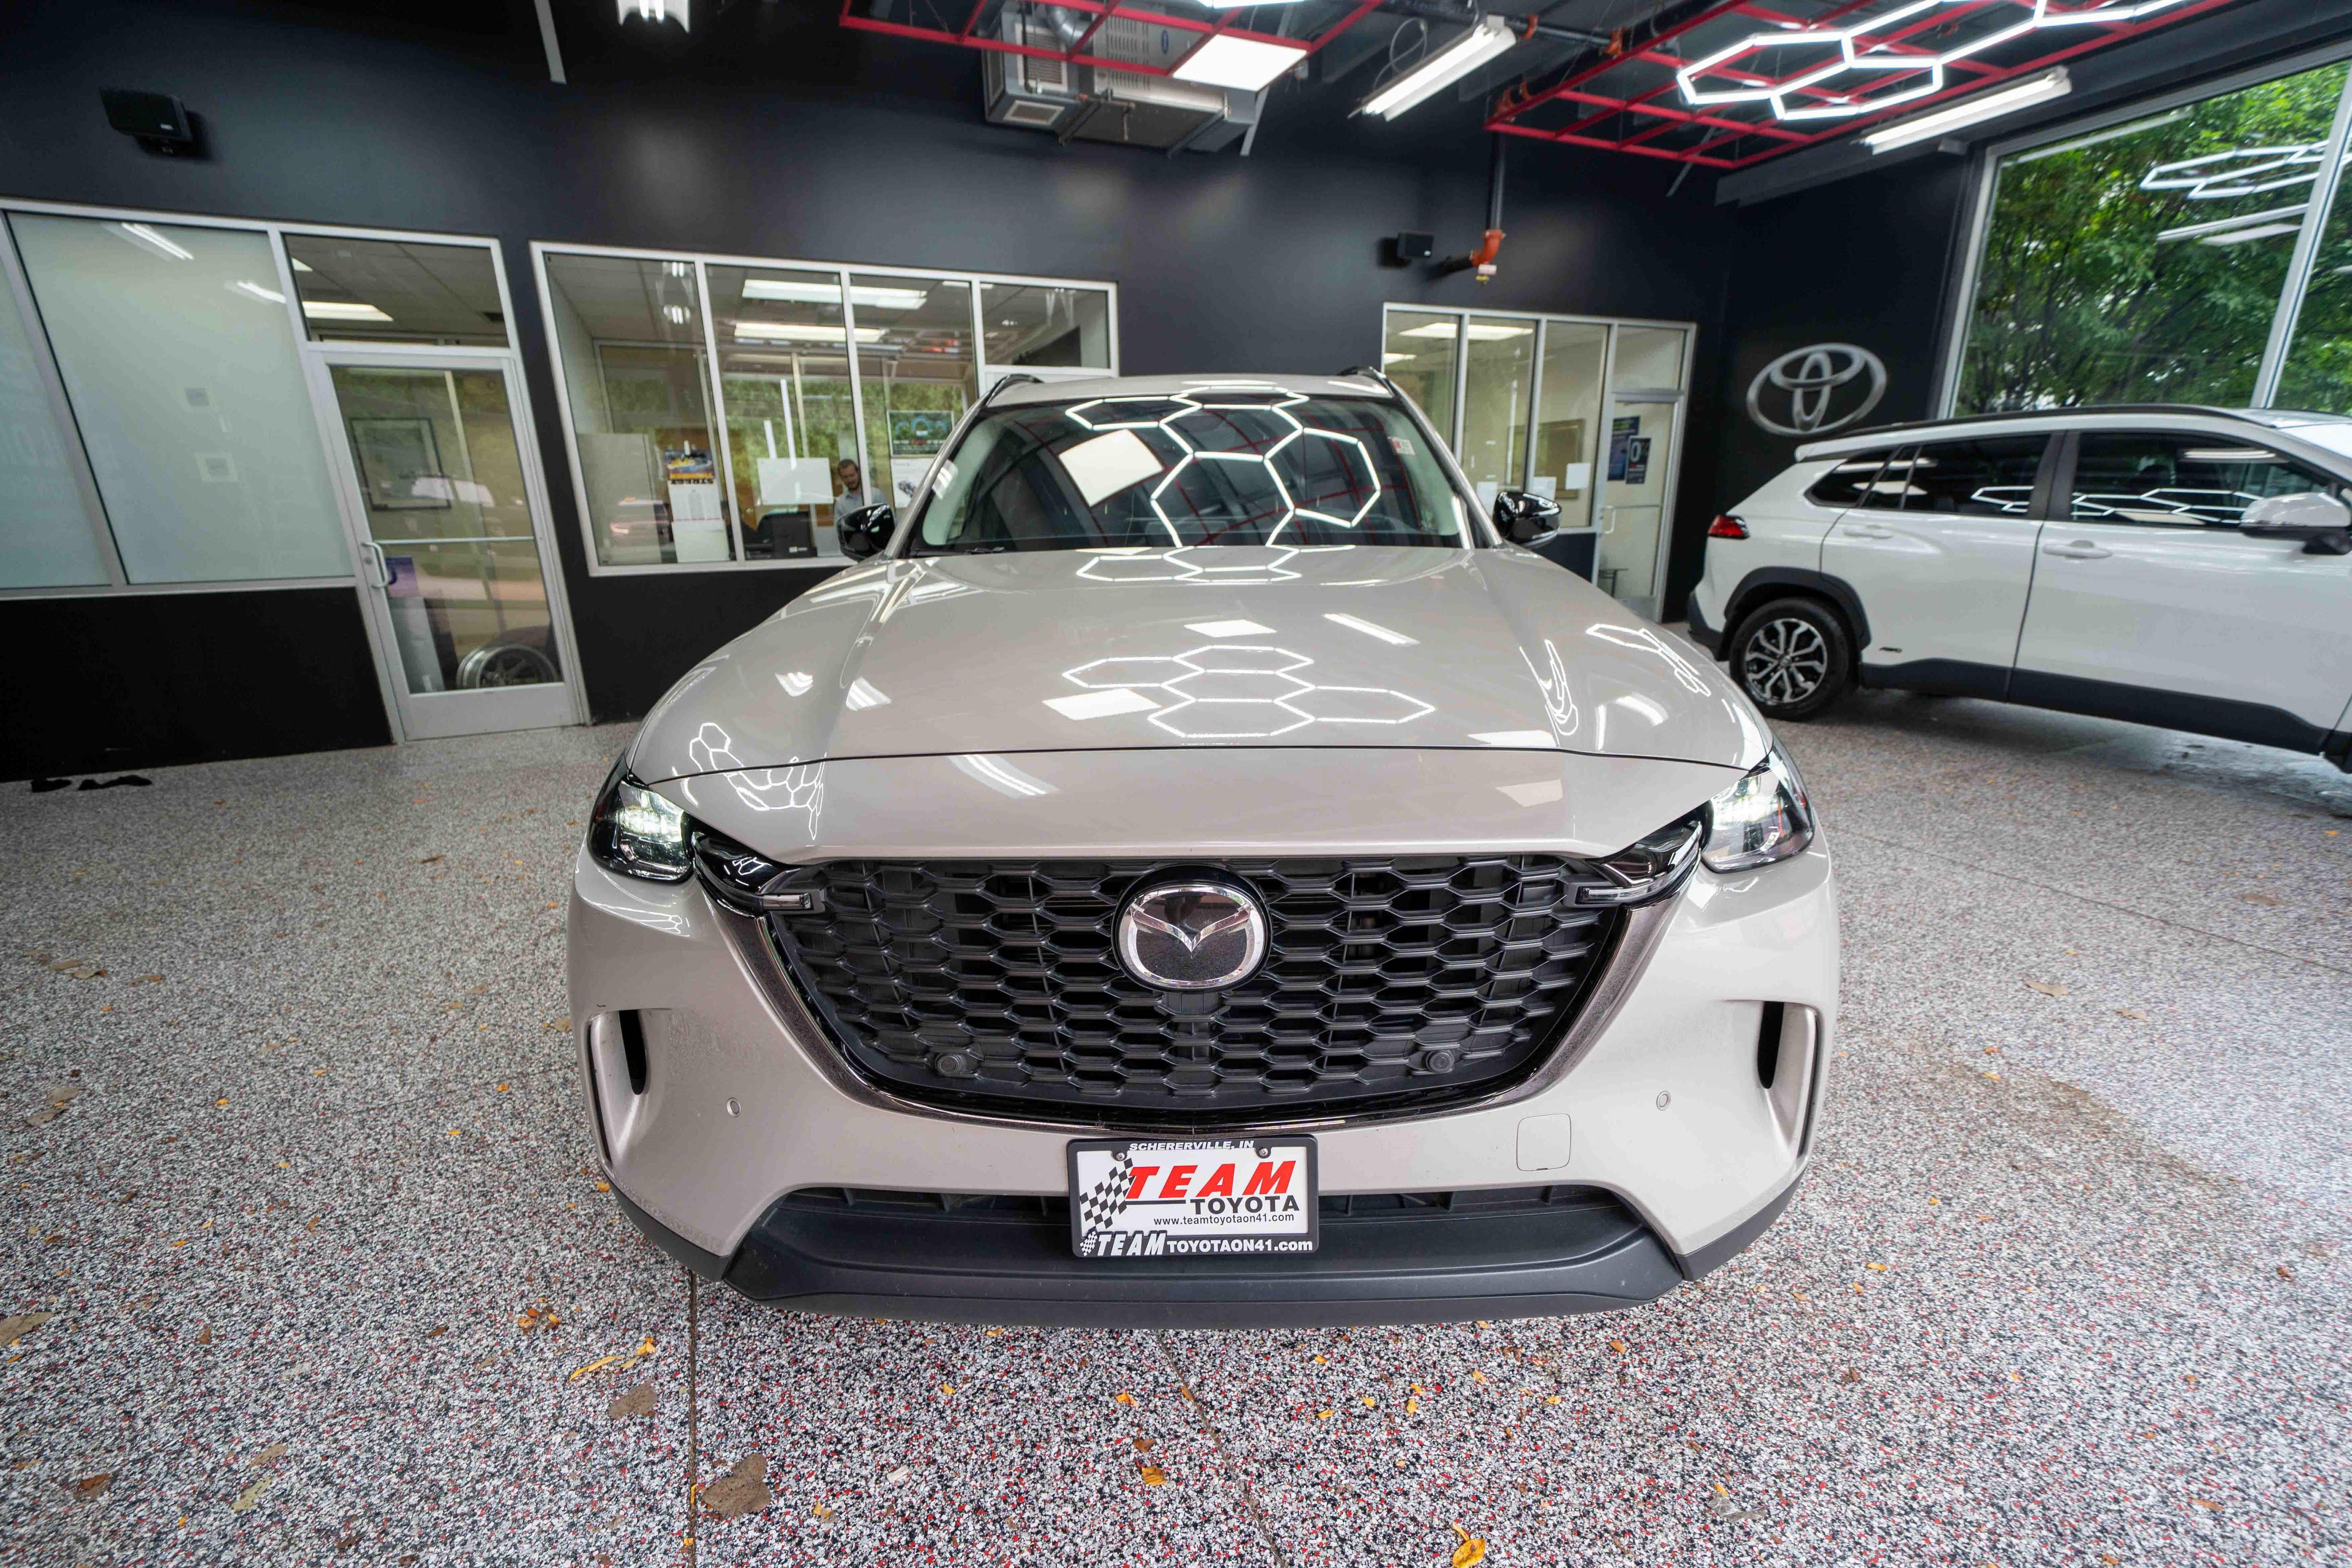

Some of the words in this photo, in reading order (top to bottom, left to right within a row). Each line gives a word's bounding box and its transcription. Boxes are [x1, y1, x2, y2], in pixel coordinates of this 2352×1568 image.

[1129, 1141, 1235, 1151] SCHERERVILLE,
[1239, 1140, 1254, 1148] IN
[1125, 1160, 1296, 1199] TEAM
[1190, 1195, 1300, 1215] TOYOTA
[1154, 1213, 1294, 1226] www.teamtoyotaon41.com
[1097, 1233, 1167, 1256] TEAM
[1167, 1239, 1313, 1253] TOYOTAON41.com
